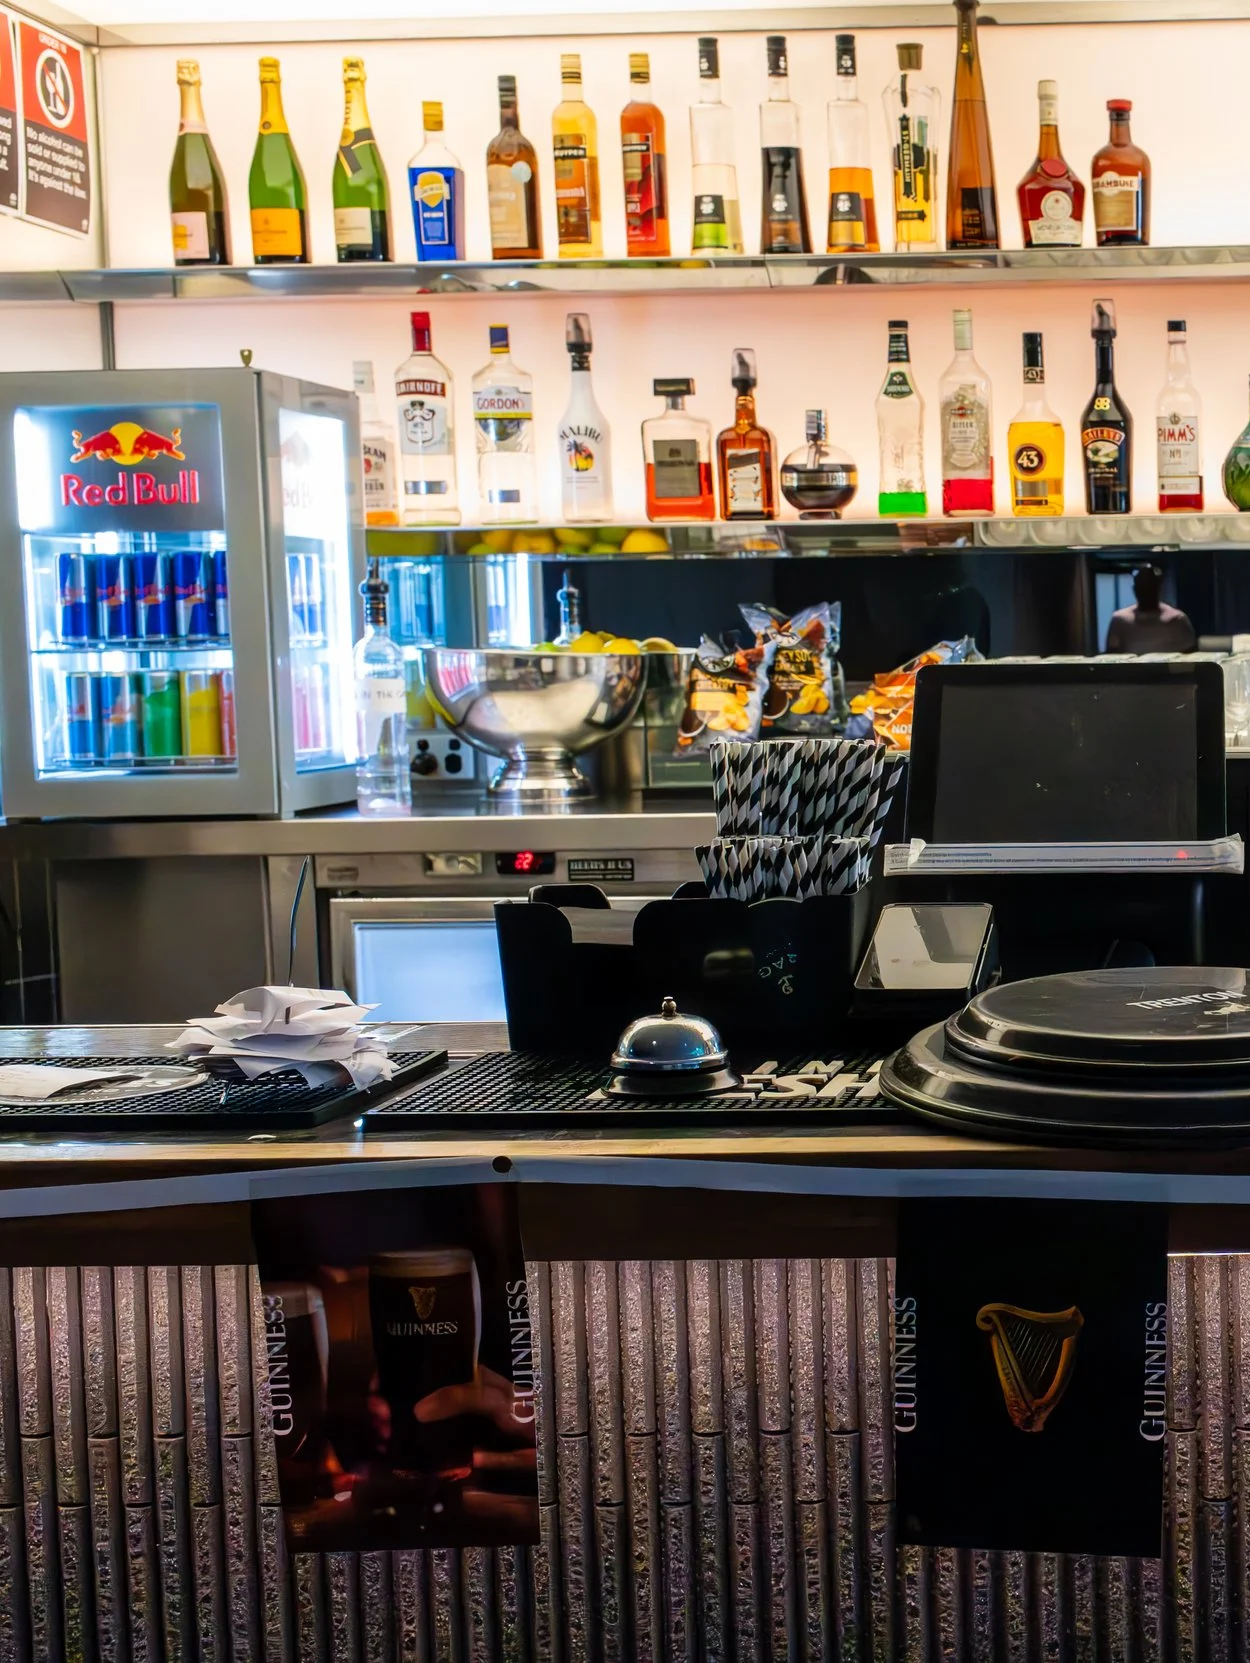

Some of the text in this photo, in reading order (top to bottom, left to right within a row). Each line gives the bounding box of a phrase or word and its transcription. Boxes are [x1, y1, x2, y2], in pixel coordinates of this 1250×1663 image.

[1017, 450, 1039, 468] 43
[1157, 424, 1196, 442] PIMM'S
[60, 470, 199, 506] Red Bull
[1126, 990, 1247, 1009] TRENTON
[264, 1294, 295, 1436] GUINNESS
[506, 1279, 537, 1424] GUINNESS
[893, 1297, 918, 1433] GUINNESS
[1139, 1301, 1168, 1442] GUINNESS
